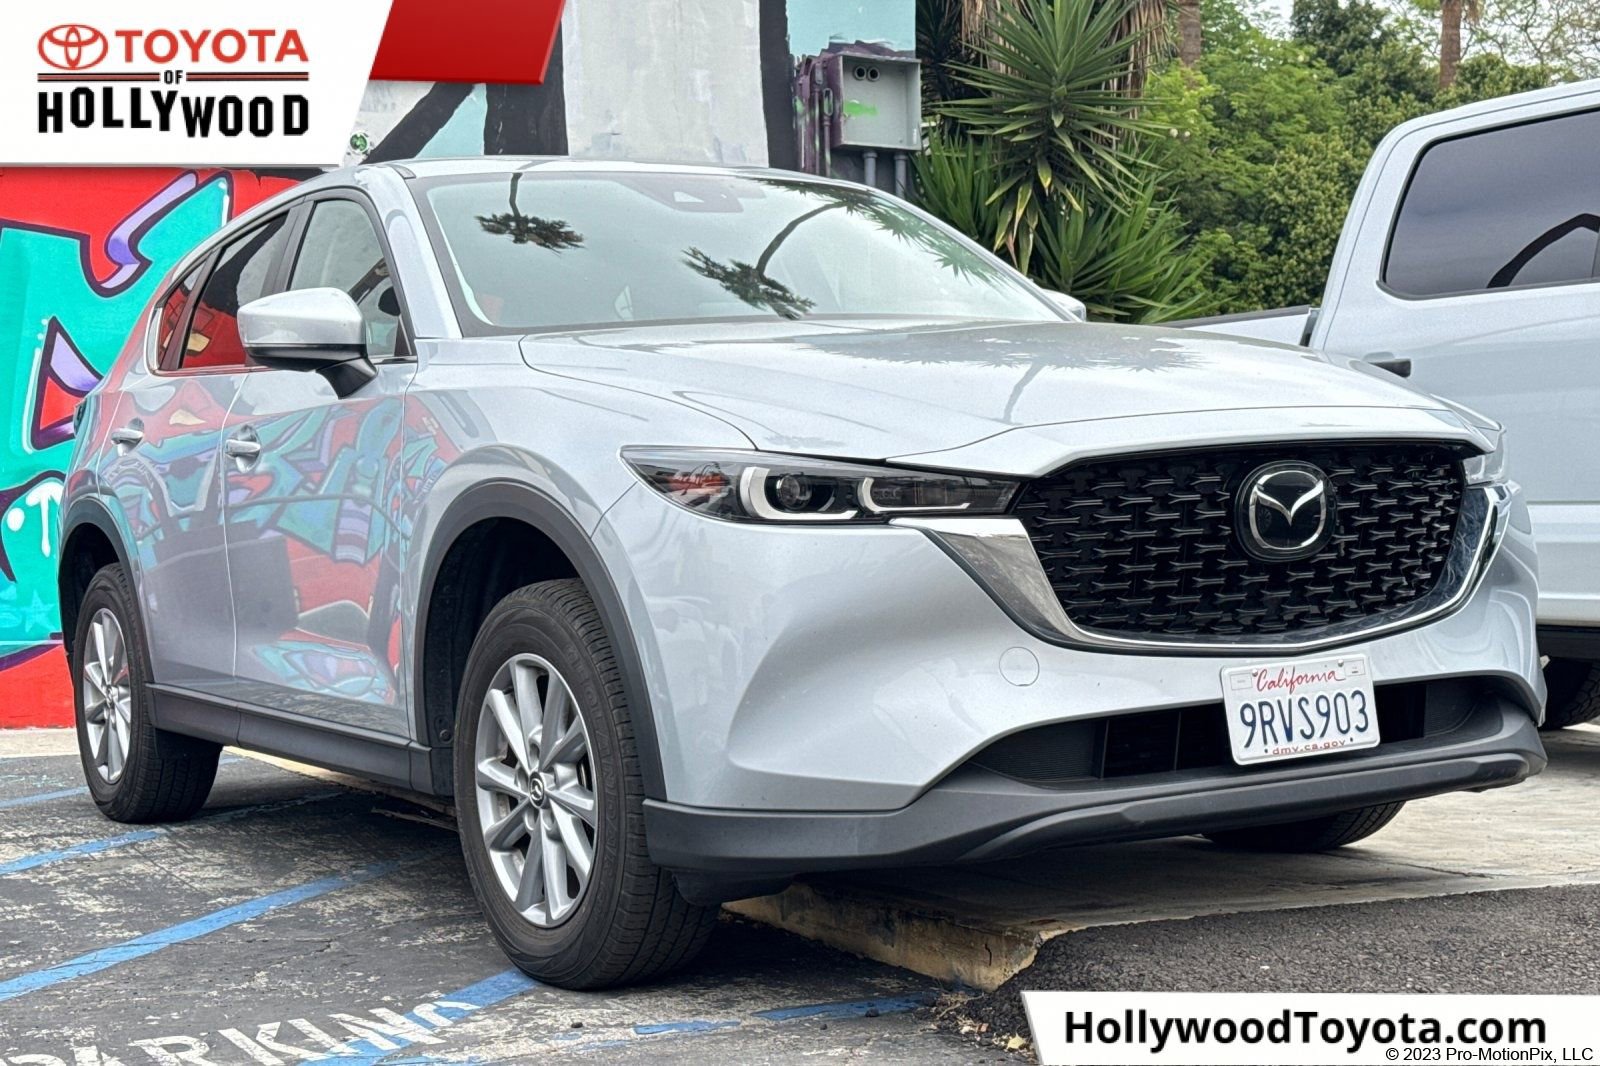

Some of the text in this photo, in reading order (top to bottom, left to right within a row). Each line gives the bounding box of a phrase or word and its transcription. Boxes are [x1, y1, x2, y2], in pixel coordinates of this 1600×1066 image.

[1256, 665, 1346, 694] California
[1240, 689, 1369, 748] 9RVS903
[1272, 739, 1346, 756] dmv.ca.gov
